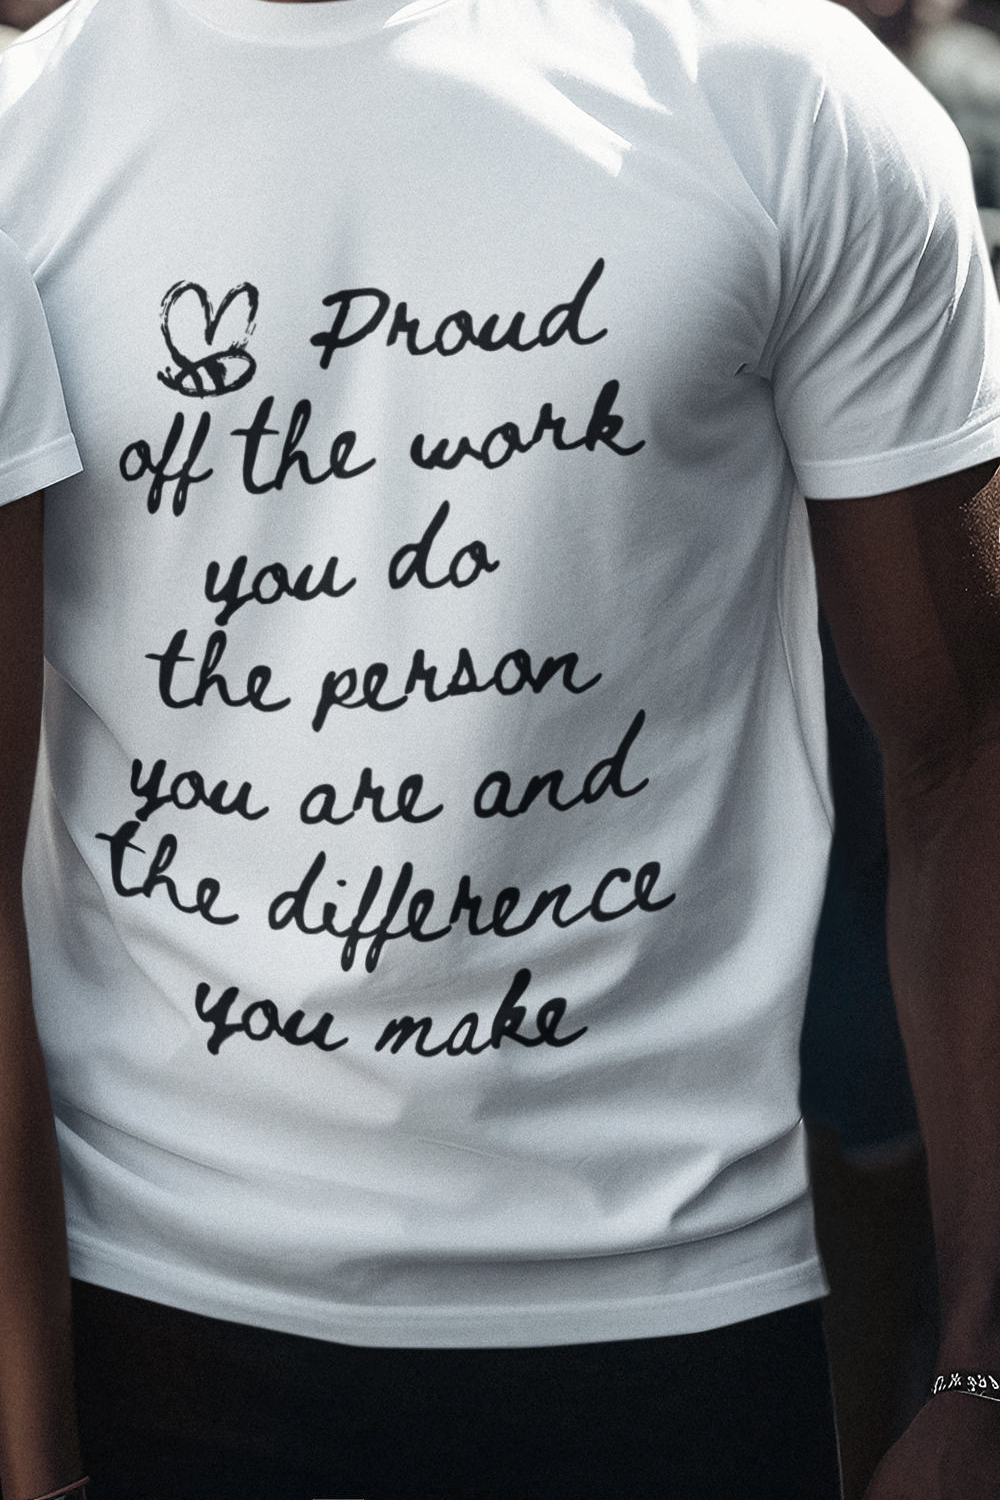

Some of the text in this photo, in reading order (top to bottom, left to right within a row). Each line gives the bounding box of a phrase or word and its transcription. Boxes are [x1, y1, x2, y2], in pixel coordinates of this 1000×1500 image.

[309, 257, 608, 370] Proud
[118, 379, 647, 517] off the work
[204, 500, 500, 627] you do
[144, 628, 603, 733] the person
[129, 708, 650, 826] you are and
[94, 820, 677, 974] the difference
[194, 967, 589, 1058] you make
